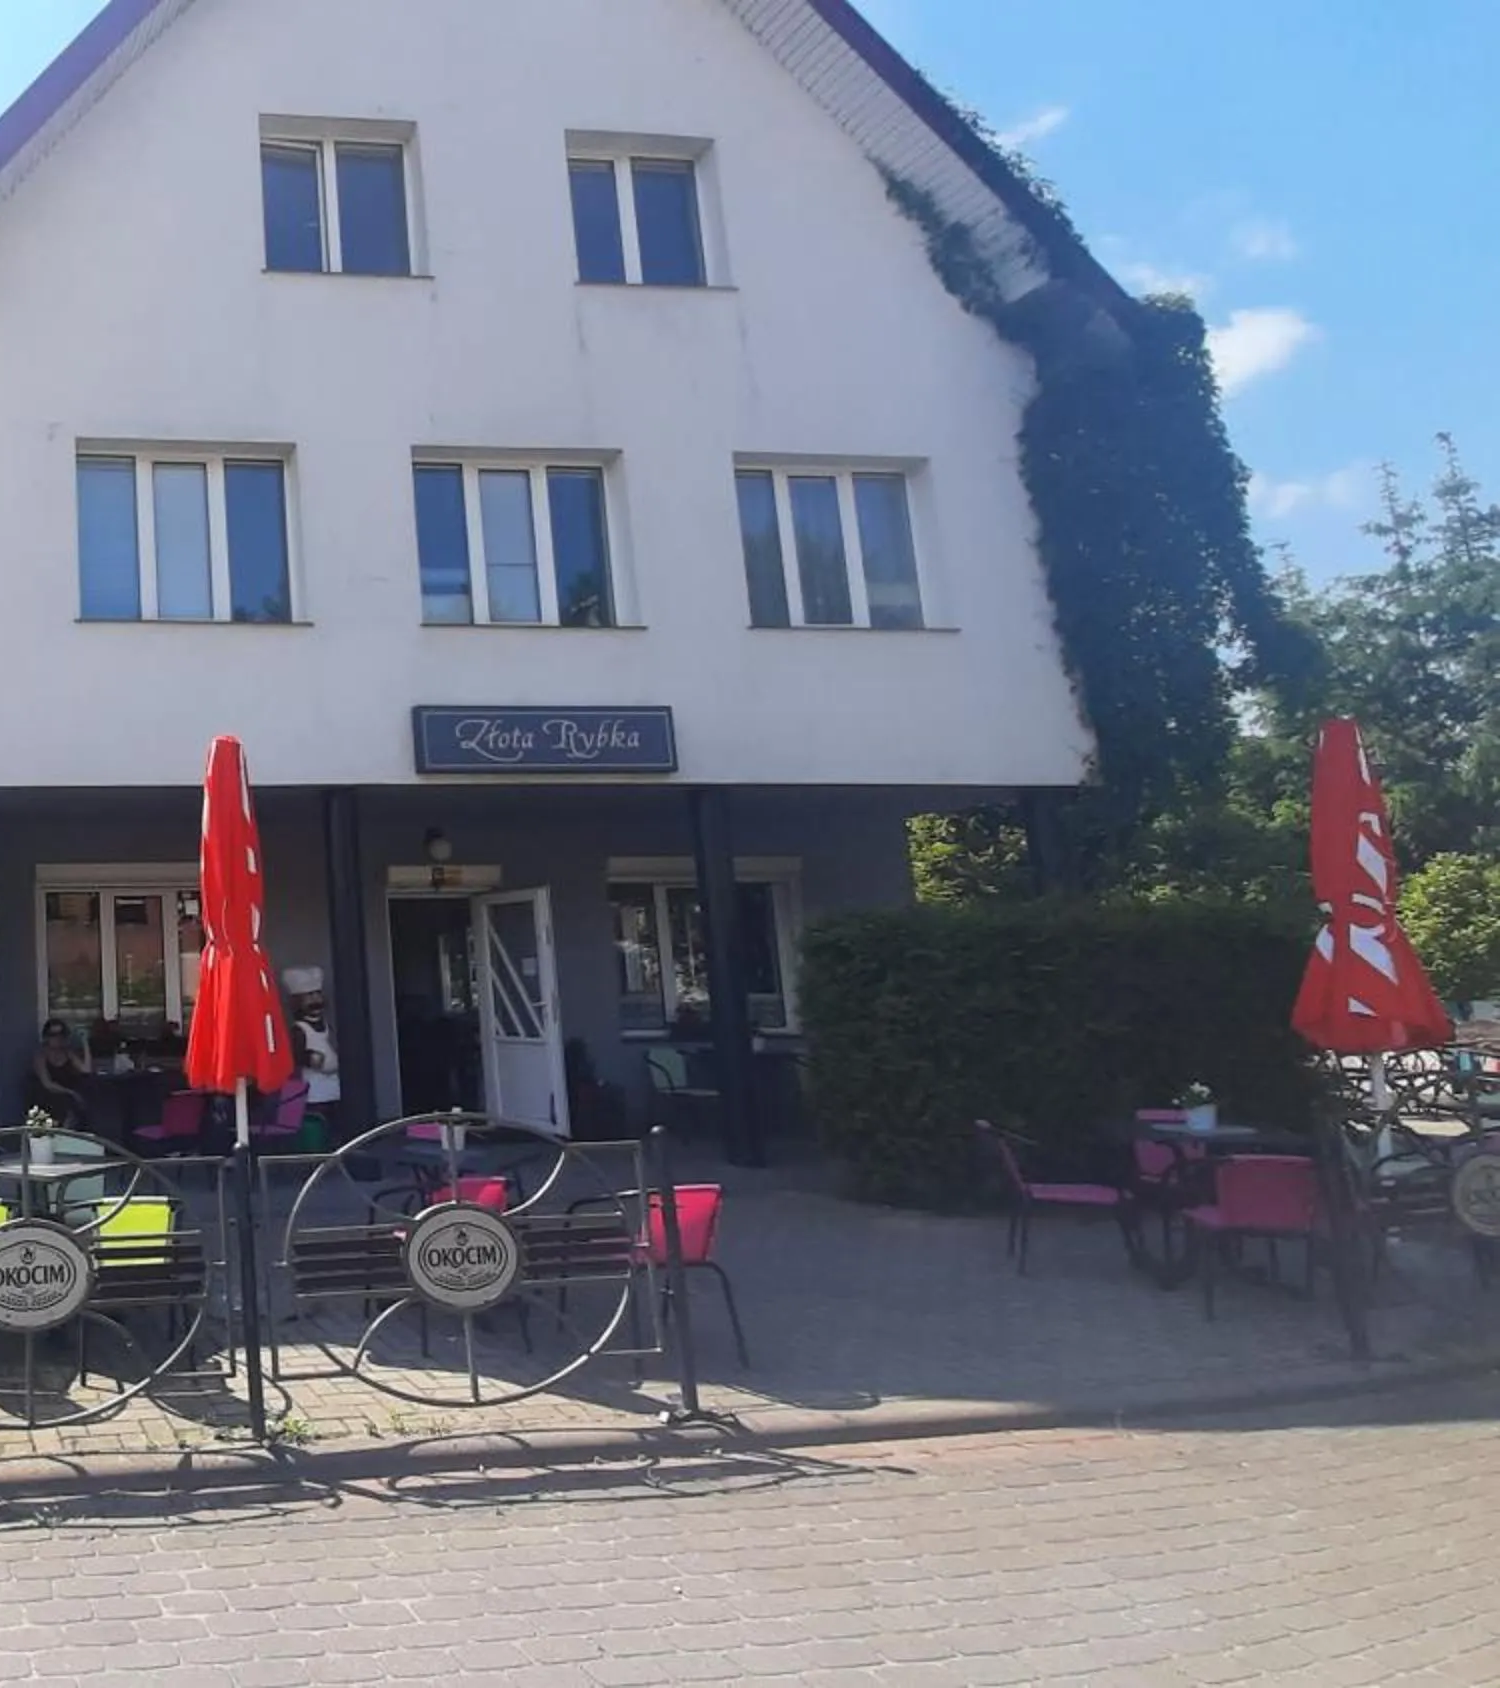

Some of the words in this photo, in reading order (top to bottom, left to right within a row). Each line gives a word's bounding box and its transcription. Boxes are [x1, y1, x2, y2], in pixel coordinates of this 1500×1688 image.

[455, 719, 534, 762] Złota
[542, 719, 640, 760] Rybka
[427, 1245, 497, 1269] OKOCIM
